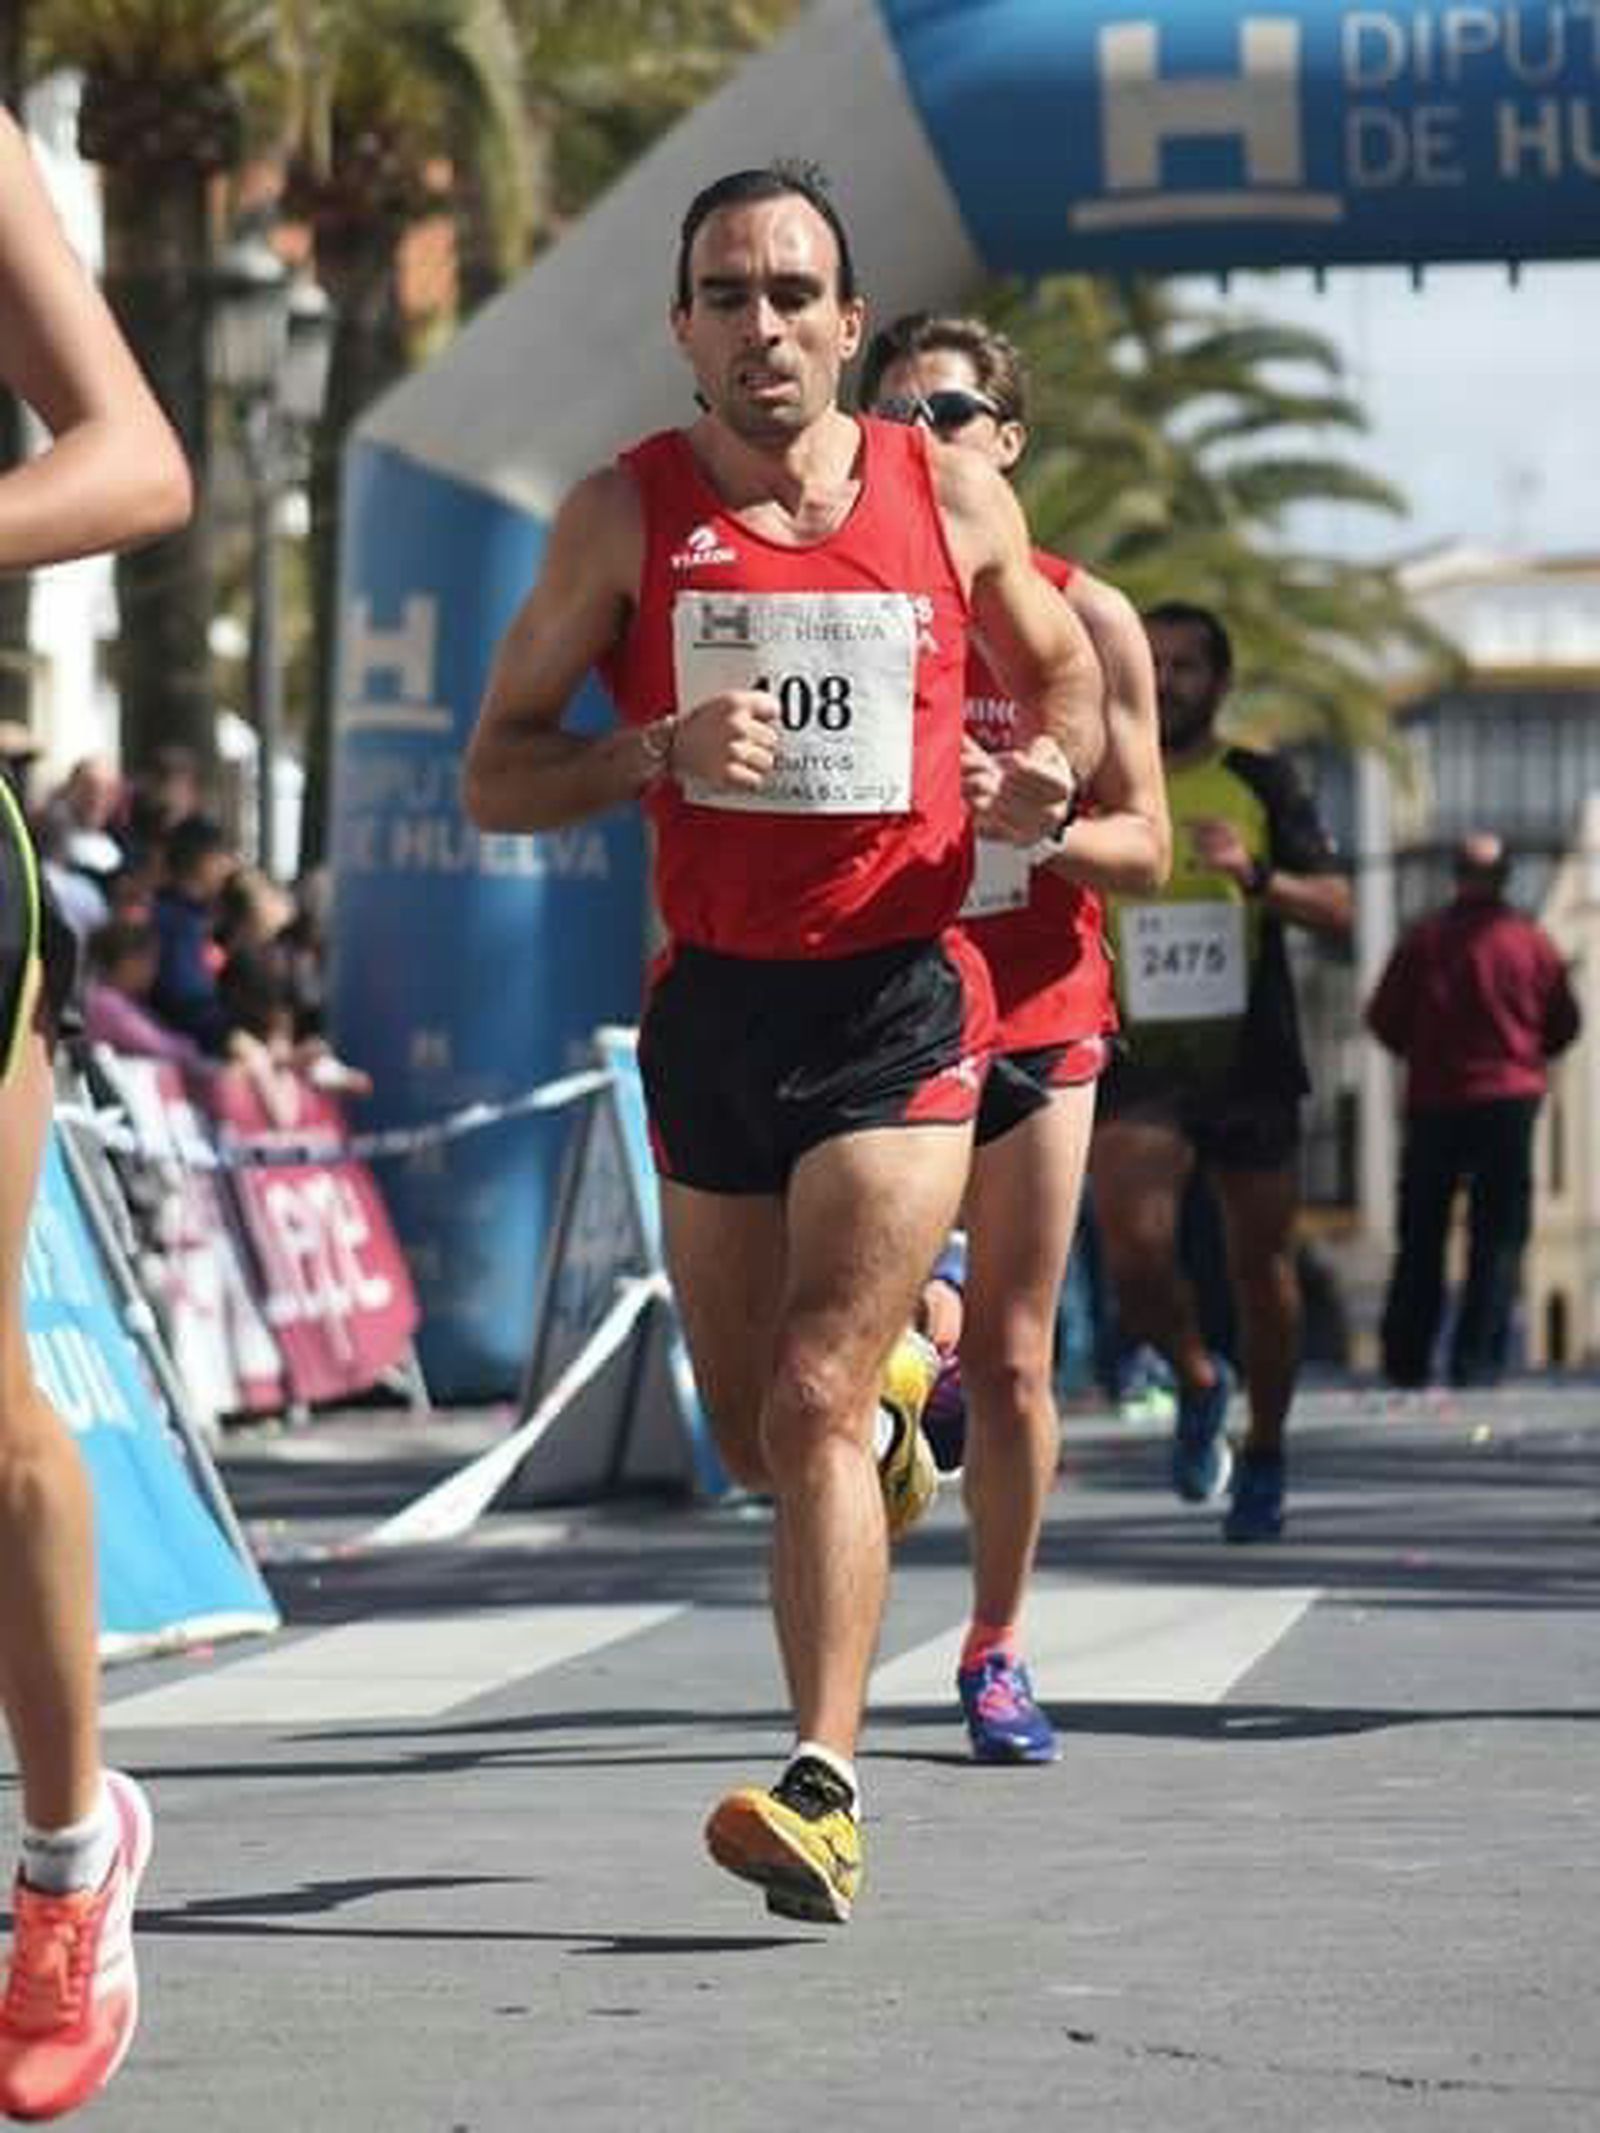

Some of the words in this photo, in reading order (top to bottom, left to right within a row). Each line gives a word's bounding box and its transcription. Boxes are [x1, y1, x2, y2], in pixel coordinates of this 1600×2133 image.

[1347, 104, 1466, 187] DE
[796, 618, 885, 641] HUELVA
[752, 674, 852, 732] 08
